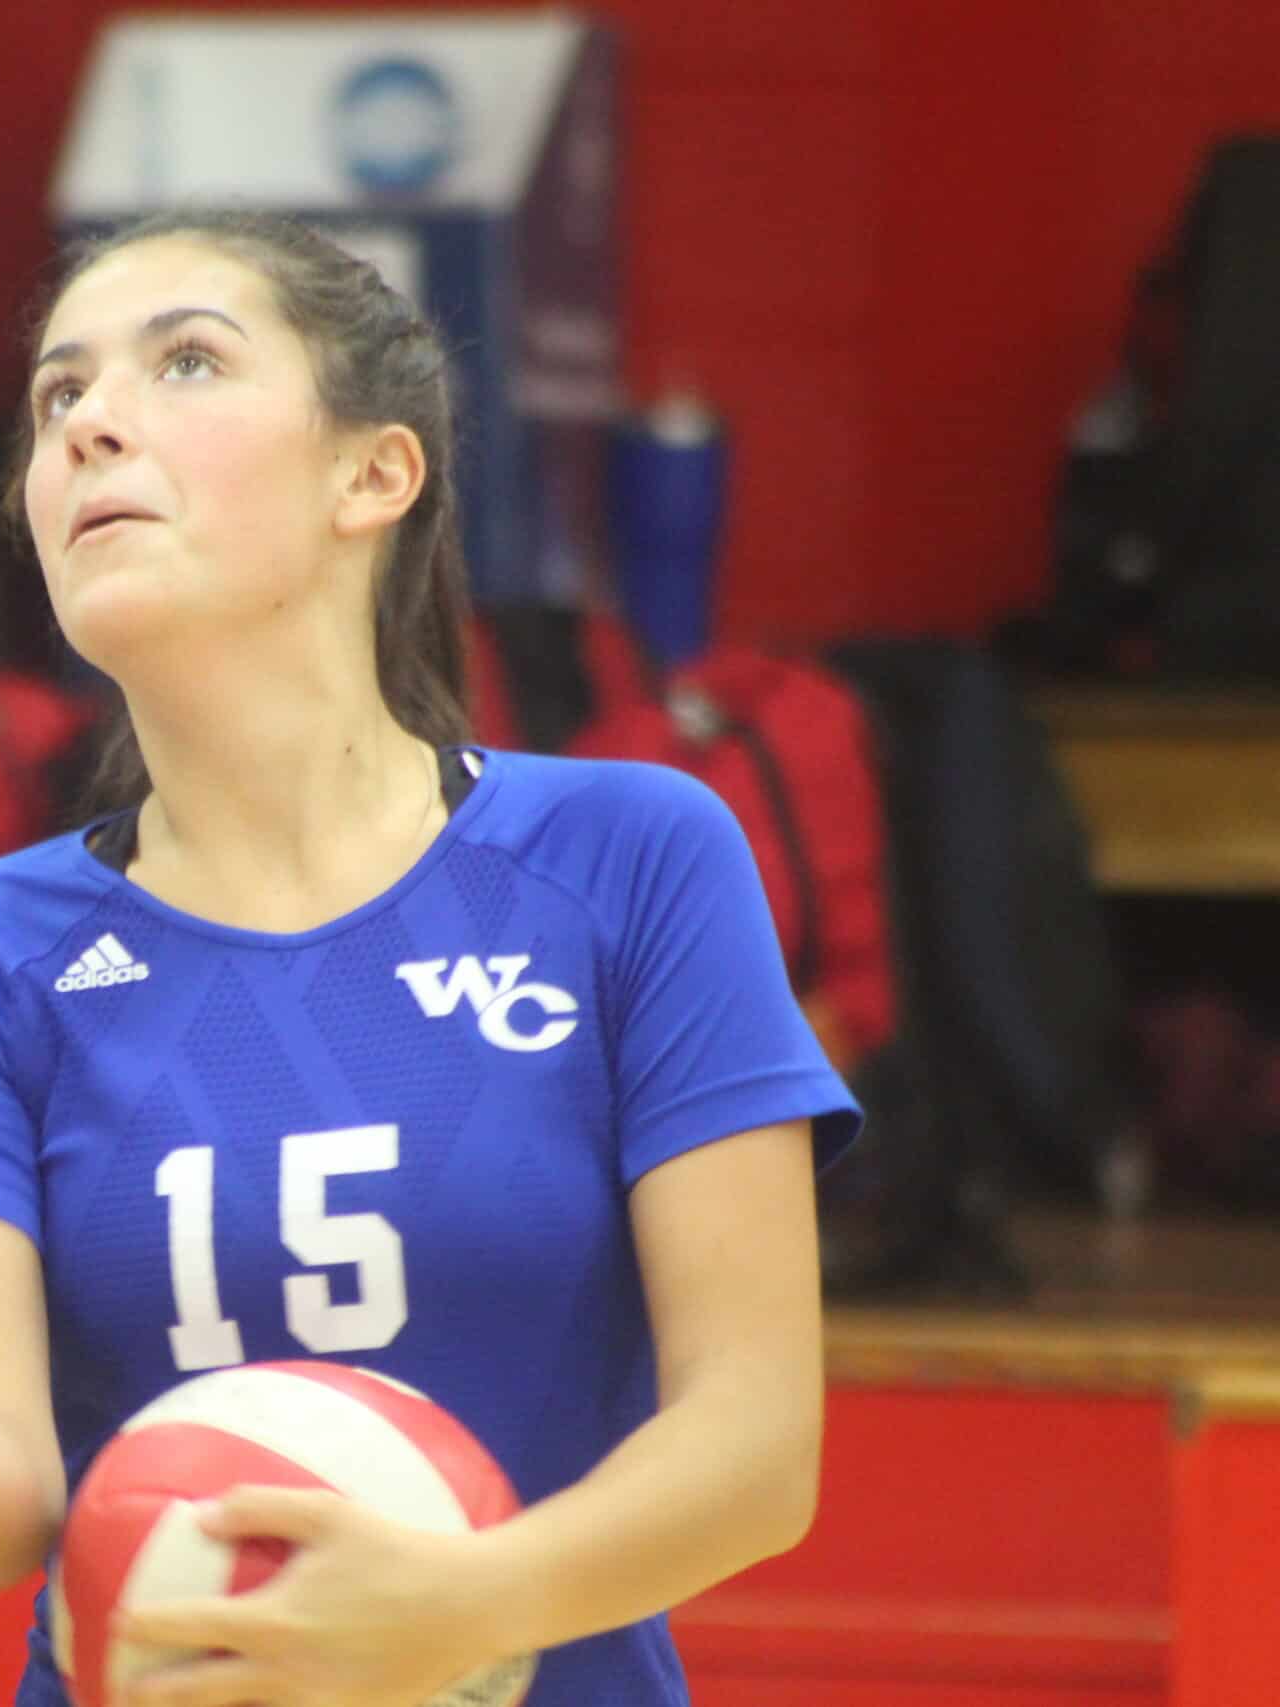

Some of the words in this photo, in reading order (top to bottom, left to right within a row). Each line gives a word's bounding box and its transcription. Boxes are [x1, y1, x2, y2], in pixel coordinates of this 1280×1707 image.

[54, 962, 150, 993] adidas
[395, 953, 578, 1052] WC
[155, 1123, 408, 1372] 15
